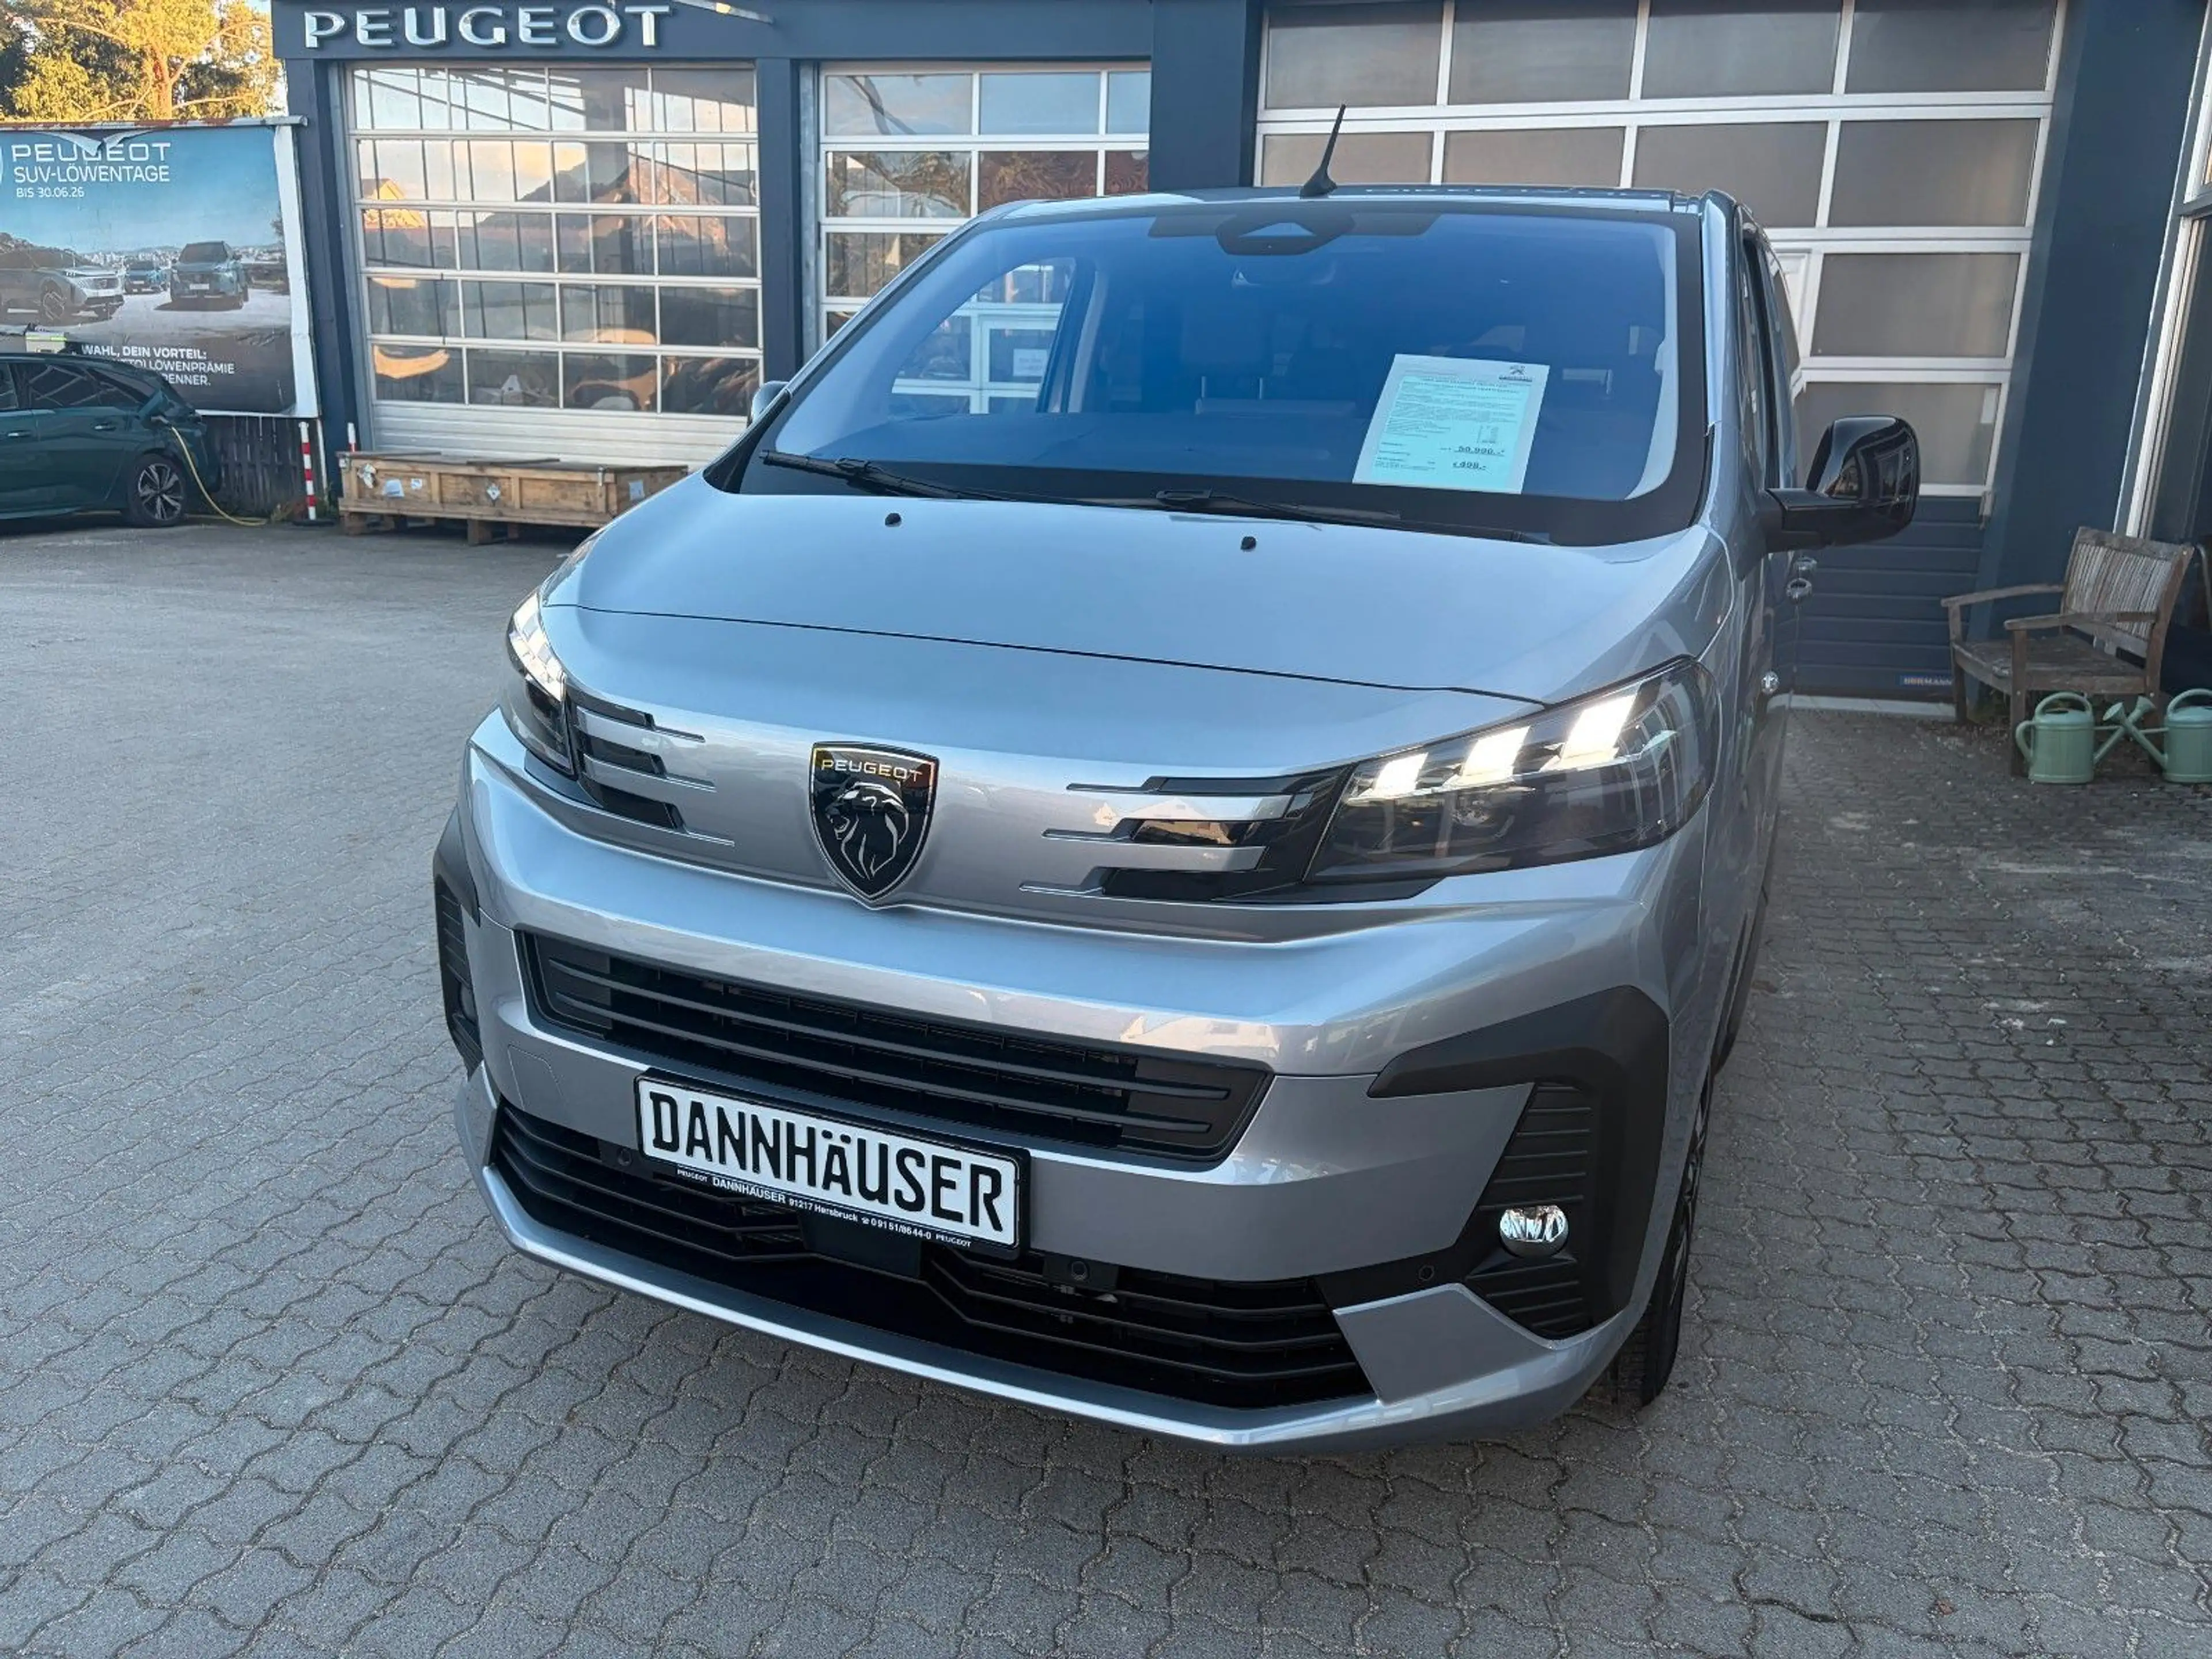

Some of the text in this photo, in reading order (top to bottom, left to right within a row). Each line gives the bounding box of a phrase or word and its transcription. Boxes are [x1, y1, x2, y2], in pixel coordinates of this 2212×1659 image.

[304, 5, 670, 48] PEUGEOT
[13, 163, 171, 184] SUV-LÖWENTAGE
[16, 187, 85, 198] BIS 30.06.26
[81, 344, 207, 359] WAHL, DEIN VORTEIL:
[821, 759, 923, 782] PEUGEOT
[650, 1091, 1002, 1232] DANNHÄUSER
[677, 1169, 708, 1182] PEUGEOT
[789, 1198, 813, 1210] 91217
[935, 1233, 972, 1248] PEUGEOT
